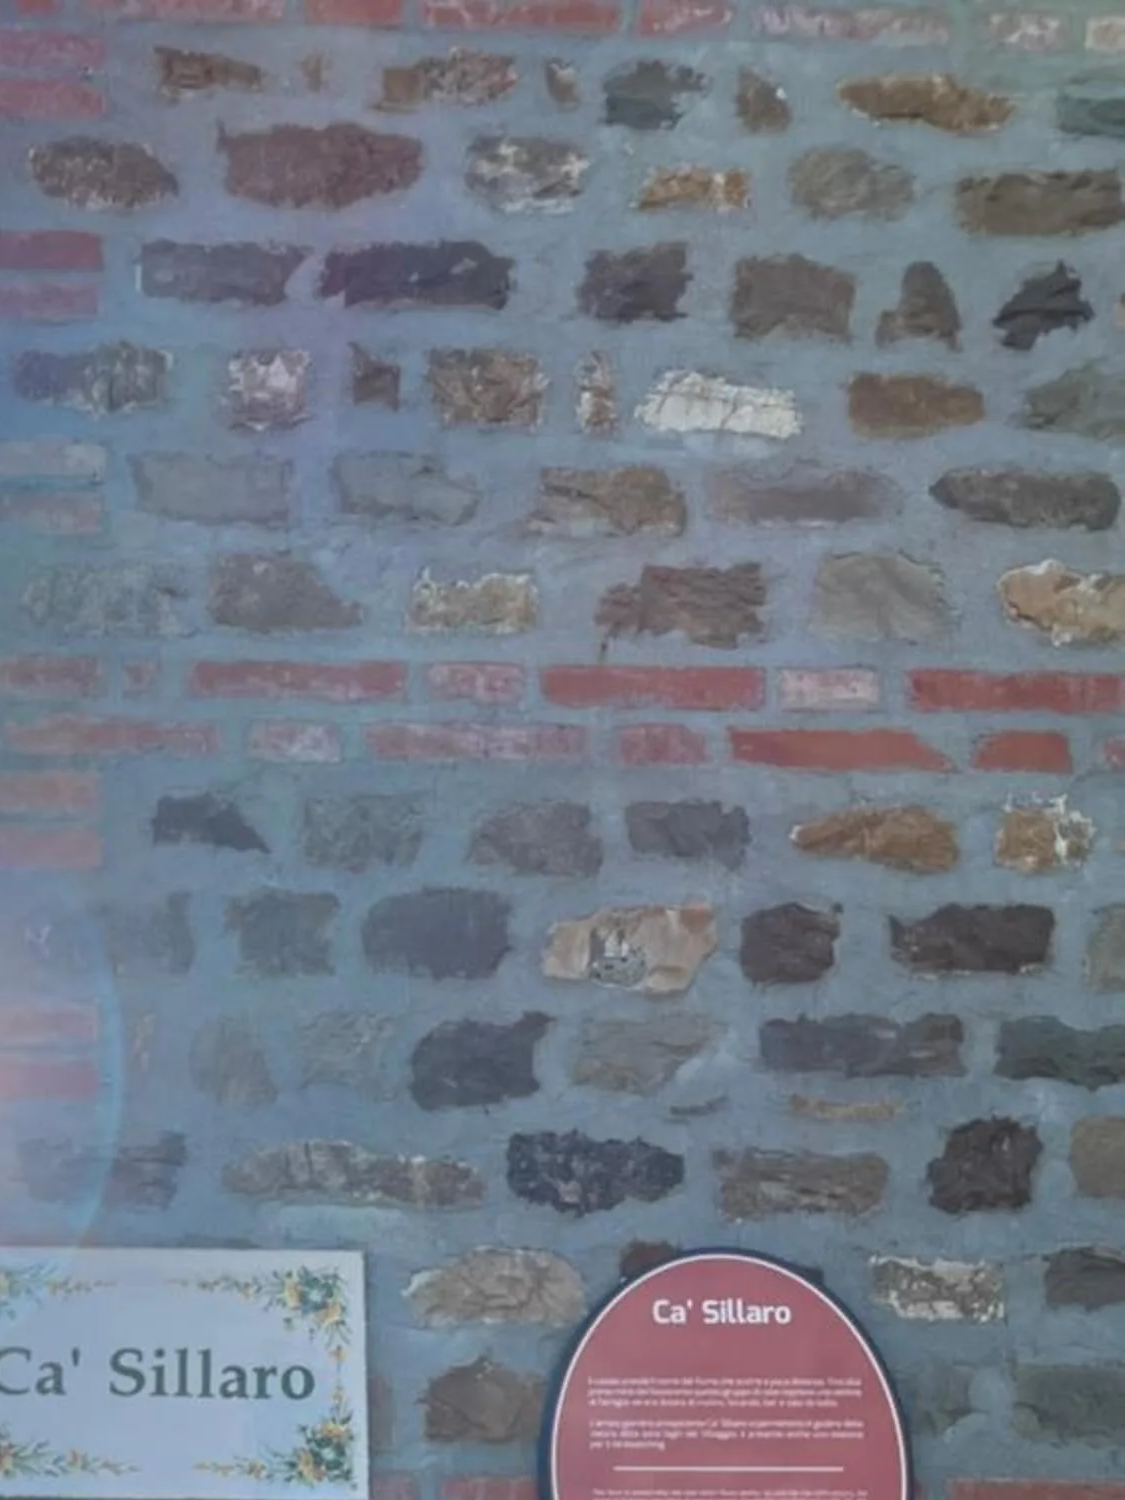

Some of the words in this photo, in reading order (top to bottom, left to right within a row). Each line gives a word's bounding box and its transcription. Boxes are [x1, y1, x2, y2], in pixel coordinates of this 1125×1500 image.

[652, 1298, 693, 1324] Ca'
[701, 1297, 792, 1325] Sillaro
[108, 1347, 316, 1400] Sillaro
